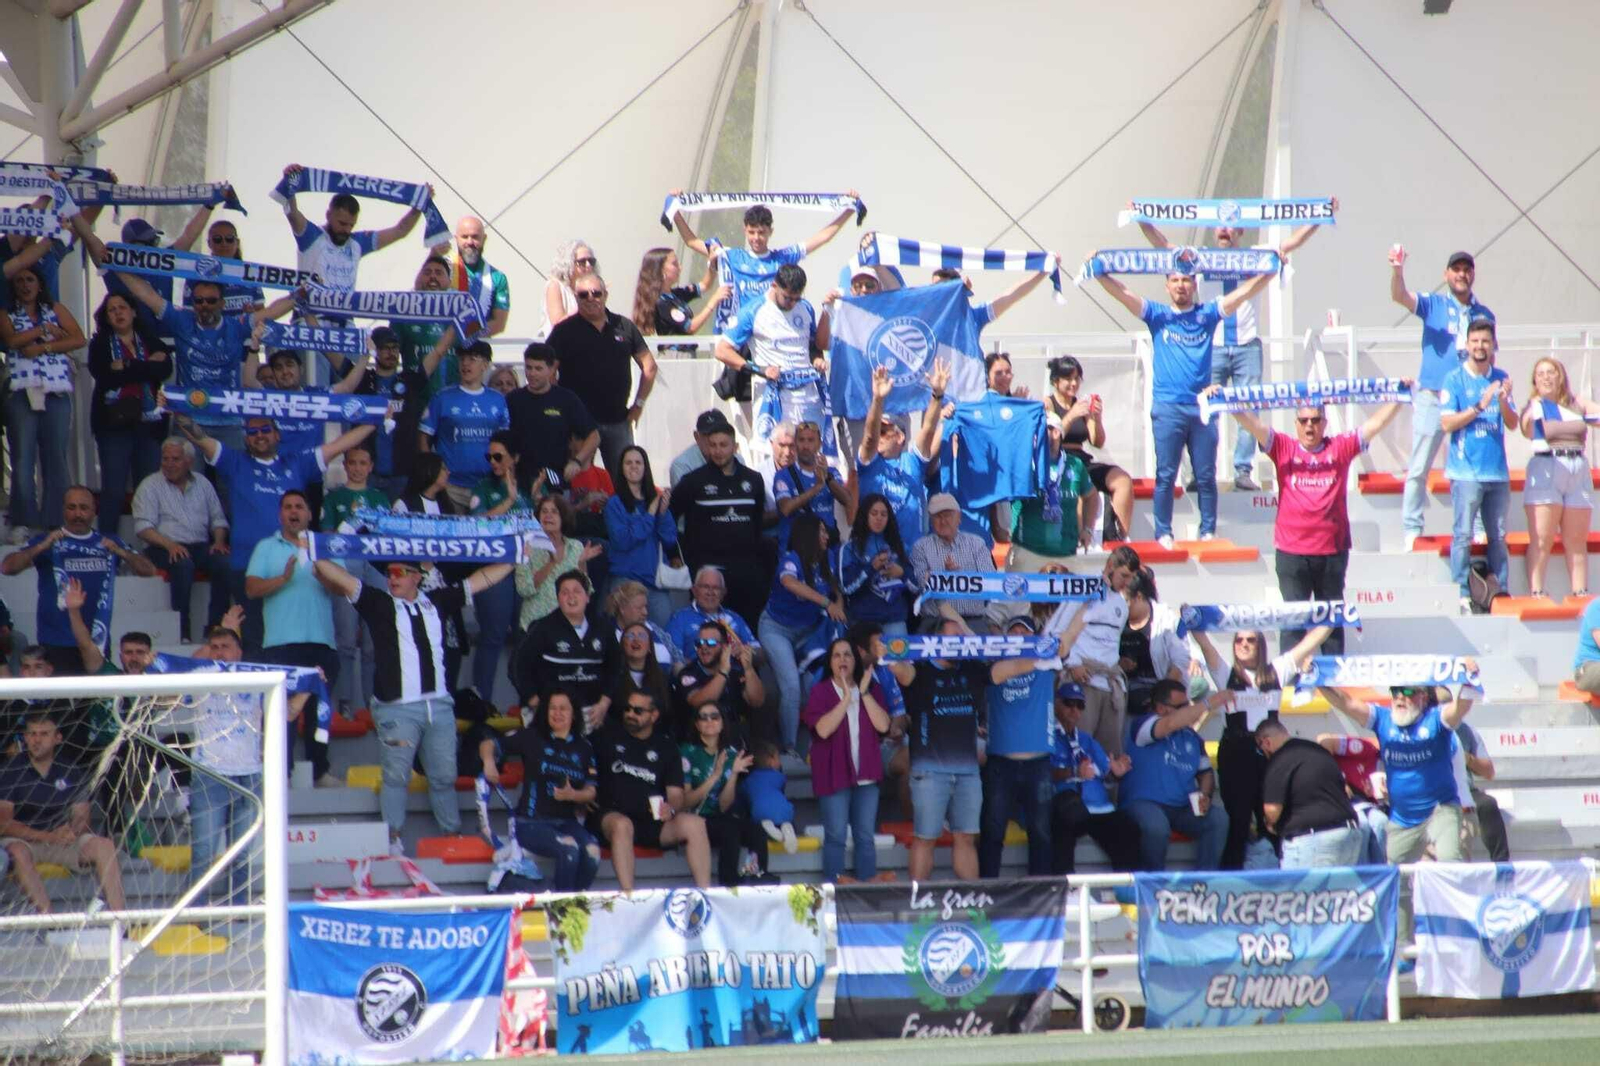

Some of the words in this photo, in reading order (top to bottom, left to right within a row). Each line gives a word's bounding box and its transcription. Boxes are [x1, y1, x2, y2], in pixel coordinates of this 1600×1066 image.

[337, 172, 405, 198] XEREZ
[781, 193, 821, 206] NADA
[1133, 202, 1198, 220] SOMOS
[1260, 202, 1334, 221] LIBRES
[101, 247, 176, 271] SOMOS
[1097, 252, 1173, 273] YOUTH
[1199, 251, 1273, 272] XEREZ
[306, 285, 353, 309] EREZ
[358, 291, 463, 317] DEPORTIVO
[281, 338, 341, 351] DEPORTIVO
[282, 325, 356, 345] XEREZ
[1222, 382, 1300, 402] FUTBOL
[1307, 377, 1402, 397] POPULAR
[221, 389, 331, 419] XEREZ
[1253, 496, 1279, 508] FILA
[360, 536, 507, 558] XERECISTAS
[926, 575, 983, 593] OMOS
[1357, 592, 1384, 604] FILA
[921, 635, 1025, 658] XEREZ
[1500, 735, 1527, 746] FILA
[309, 831, 317, 842] 3
[910, 880, 936, 910] La
[941, 888, 994, 920] gran
[1156, 881, 1220, 925] PEÑA
[1221, 889, 1377, 926] XERECISTAS
[299, 915, 371, 947] XEREZ
[376, 926, 405, 949] TE
[407, 925, 489, 950] ADOBO
[1237, 933, 1294, 967] POR
[565, 960, 641, 1016] PEÑA
[746, 950, 817, 990] TATO
[1205, 975, 1237, 1009] EL
[1241, 975, 1330, 1009] MUNDO
[900, 1010, 994, 1039] Familia
